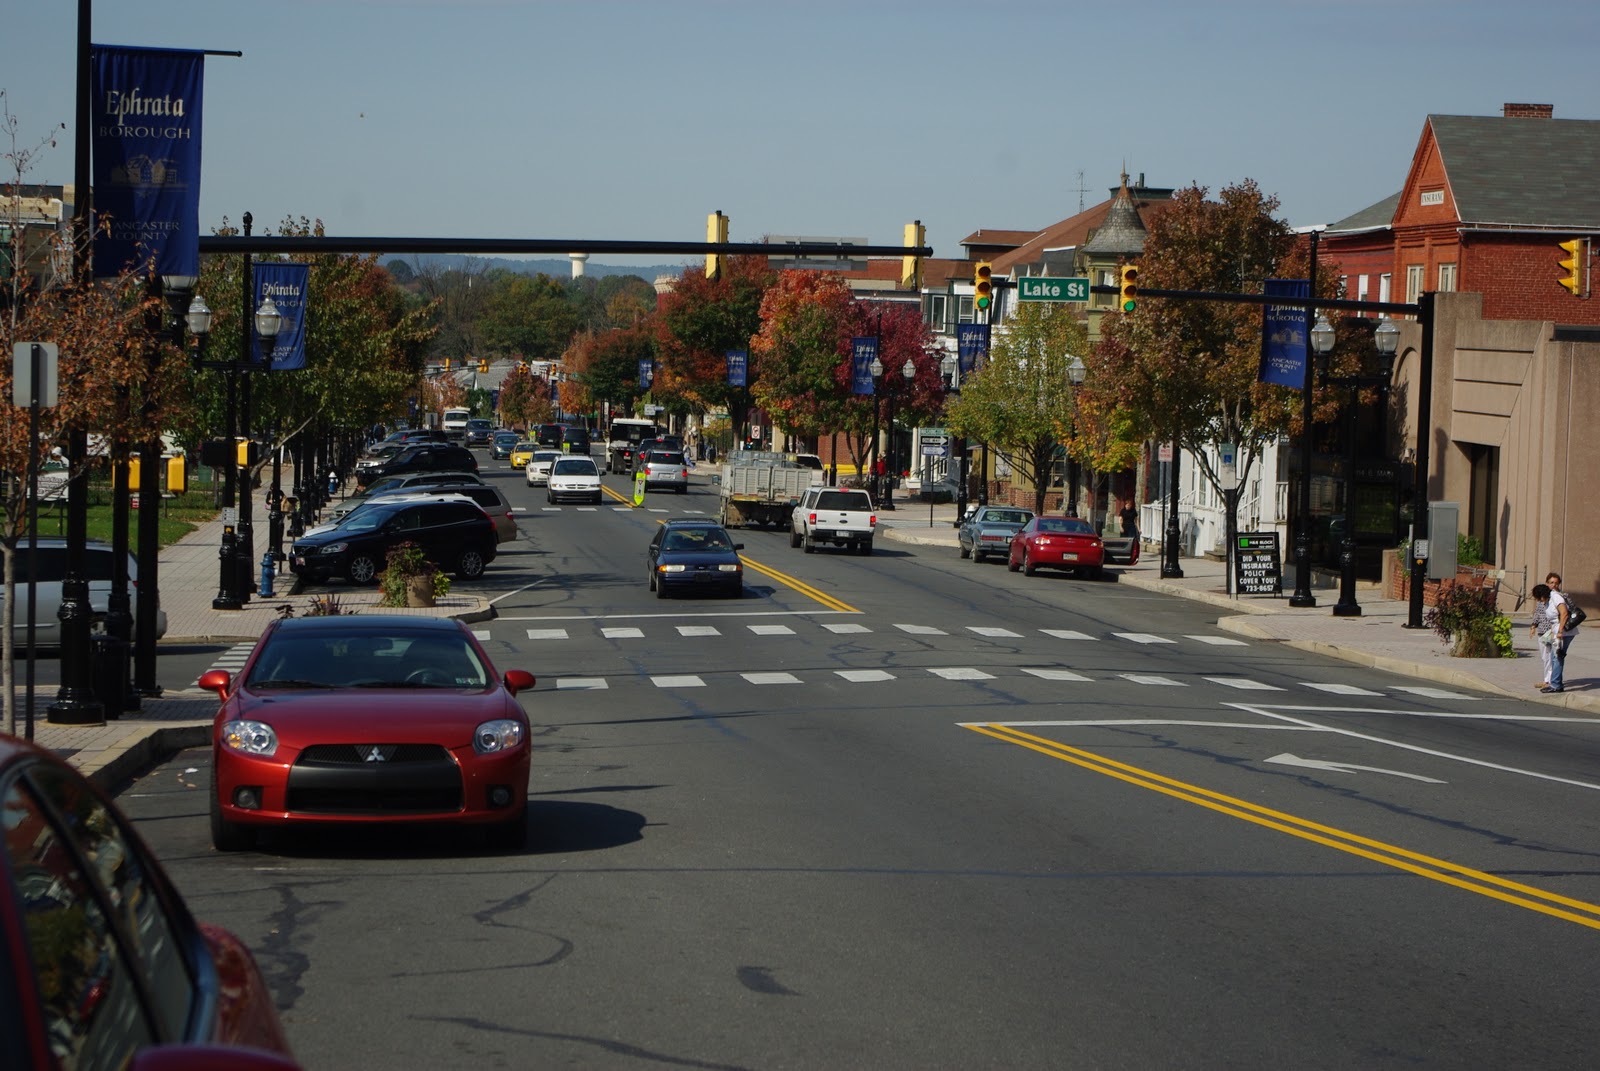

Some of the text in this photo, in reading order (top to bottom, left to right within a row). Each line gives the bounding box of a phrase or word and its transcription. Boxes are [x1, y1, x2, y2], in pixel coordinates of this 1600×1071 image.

[105, 87, 185, 126] Ephrata
[99, 126, 191, 139] BOROUGH
[112, 221, 180, 231] ANCASTER
[115, 231, 170, 240] COUNTY
[262, 281, 300, 296] Ephrata
[1023, 282, 1084, 297] Lake St
[1241, 562, 1274, 570] INSURANCE
[1239, 577, 1259, 585] COVER
